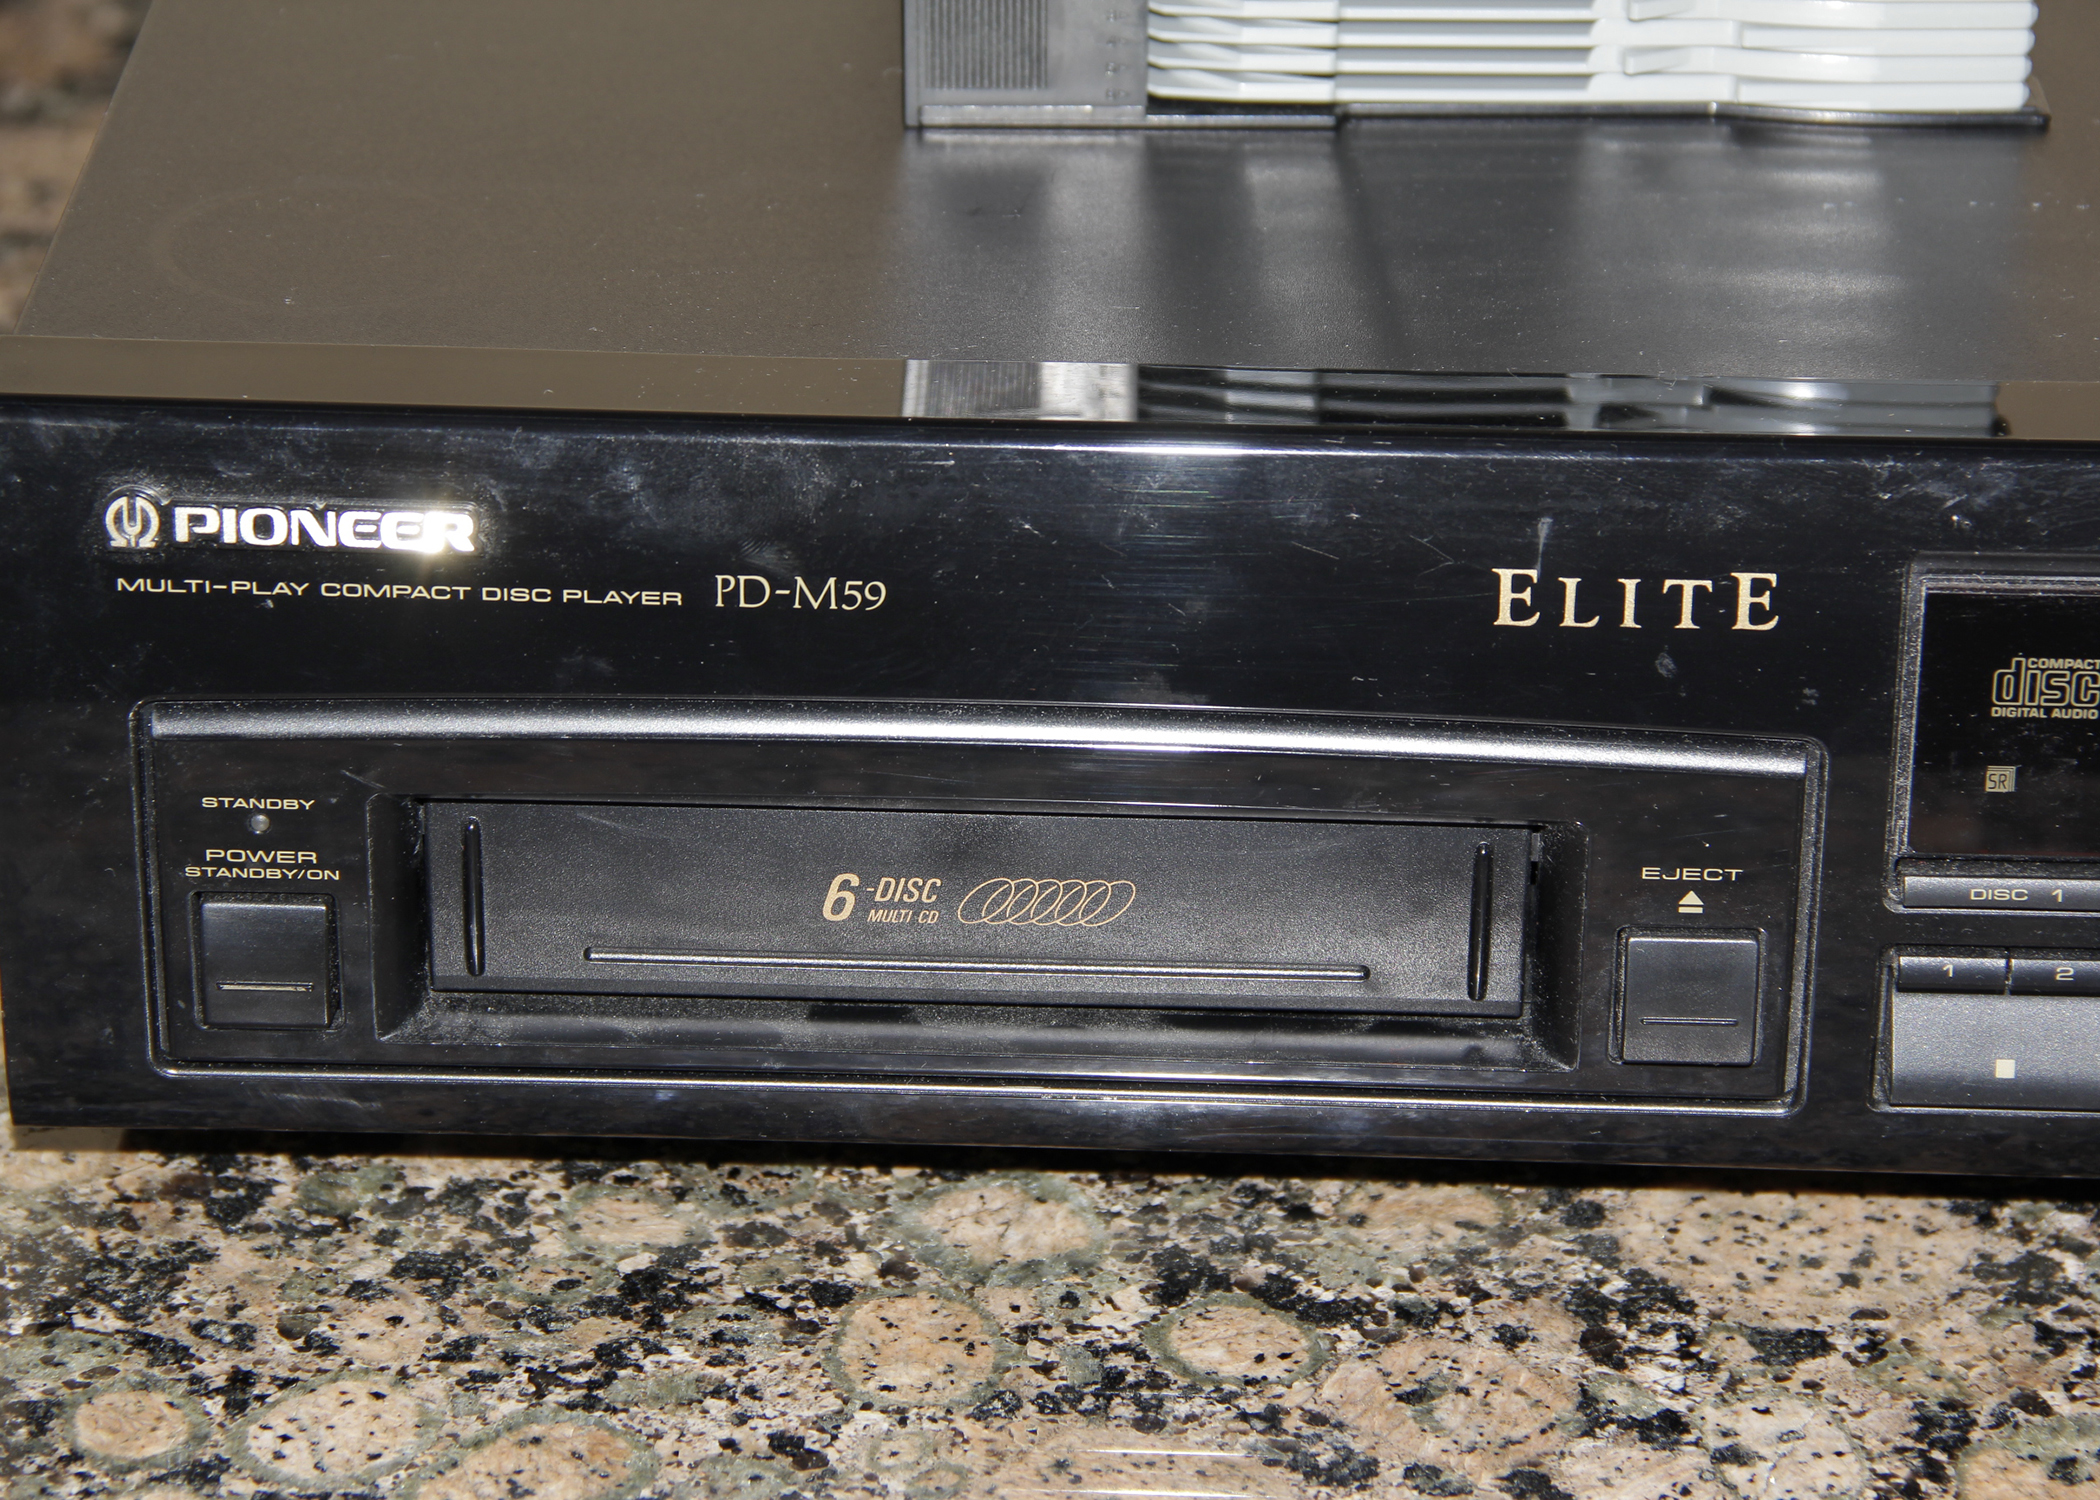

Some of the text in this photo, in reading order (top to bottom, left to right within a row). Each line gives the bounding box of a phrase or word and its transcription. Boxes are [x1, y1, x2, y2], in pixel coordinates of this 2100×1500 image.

[173, 506, 475, 554] PIONEER
[117, 574, 887, 611] MULTI-PLAY COMPACT DISC PLAYER PD-M59
[1491, 568, 1780, 631] ELITE
[1990, 706, 2099, 720] DIGITAL AUDIO
[1987, 773, 2008, 790] SR
[201, 797, 315, 810] STANDBY
[205, 849, 317, 864] POWER
[184, 866, 340, 881] STANDBY/ON
[1641, 867, 1743, 881] EJECT
[1969, 889, 2063, 903] DISC 1
[867, 909, 939, 924] MULTI CD
[1942, 964, 1954, 978] 1
[2055, 967, 2075, 981] 2
